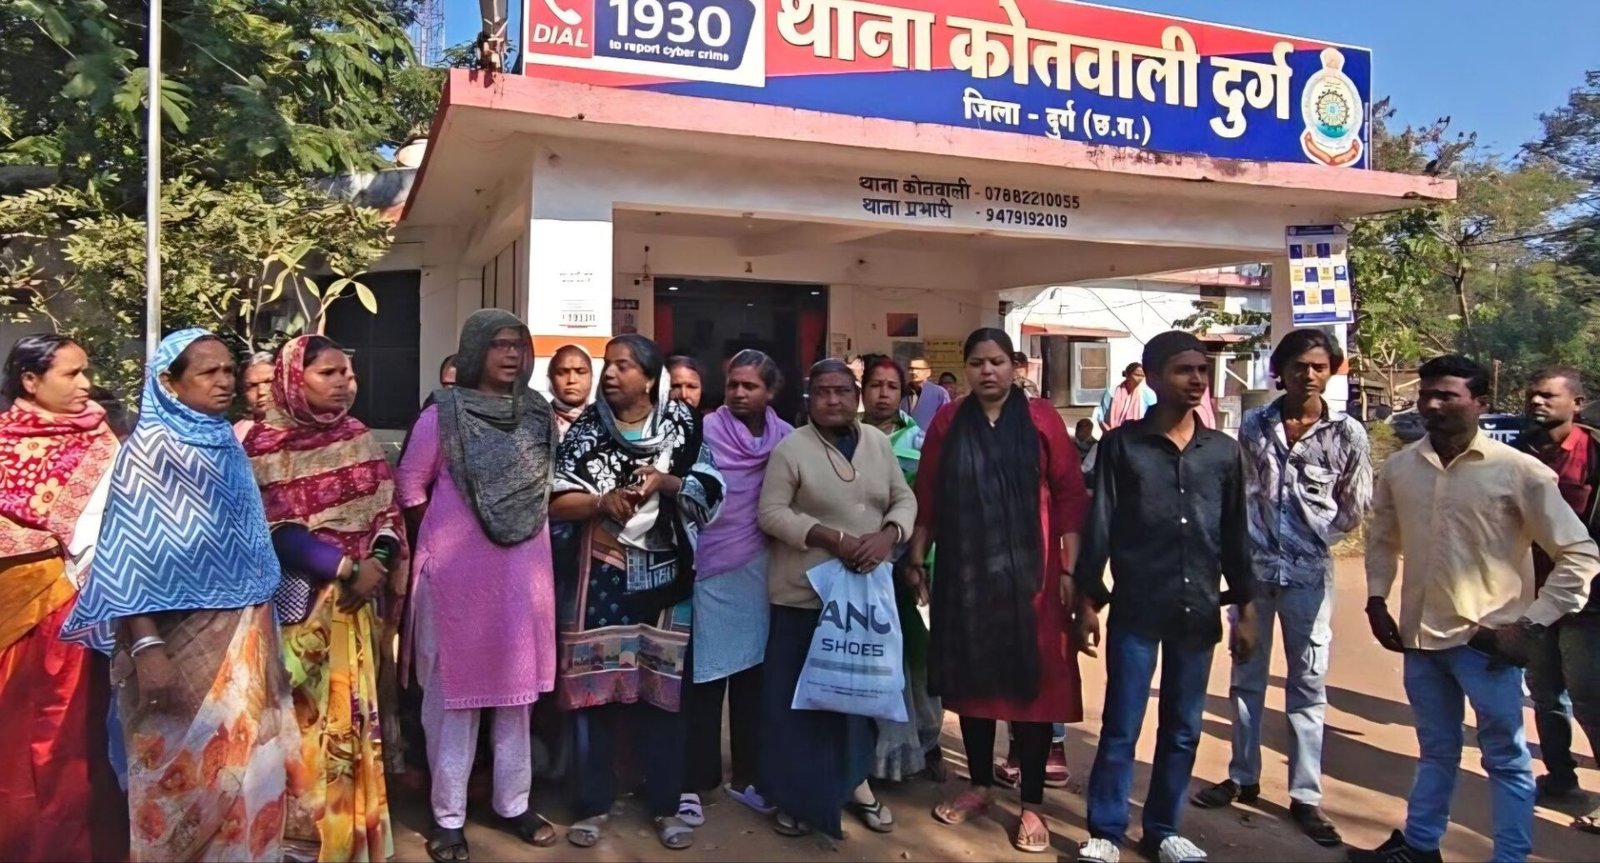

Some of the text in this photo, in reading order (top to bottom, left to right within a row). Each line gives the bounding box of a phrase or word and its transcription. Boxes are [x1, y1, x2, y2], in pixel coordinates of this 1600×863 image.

[533, 23, 589, 48] DIAL
[608, 0, 731, 47] 1930
[609, 39, 729, 62] to report cyber crime
[777, 0, 1294, 138] थाना कोतवाली दुर्ग
[963, 87, 1021, 125] जिला
[1045, 100, 1076, 139] दुर्ग
[859, 176, 898, 194] थाना
[903, 175, 971, 200] कोतवाली
[985, 186, 1080, 209] 07882210055
[862, 198, 900, 216] थाना
[905, 198, 953, 219] प्रभारी
[986, 208, 1067, 228] 9479192019
[821, 638, 884, 657] SHOES
